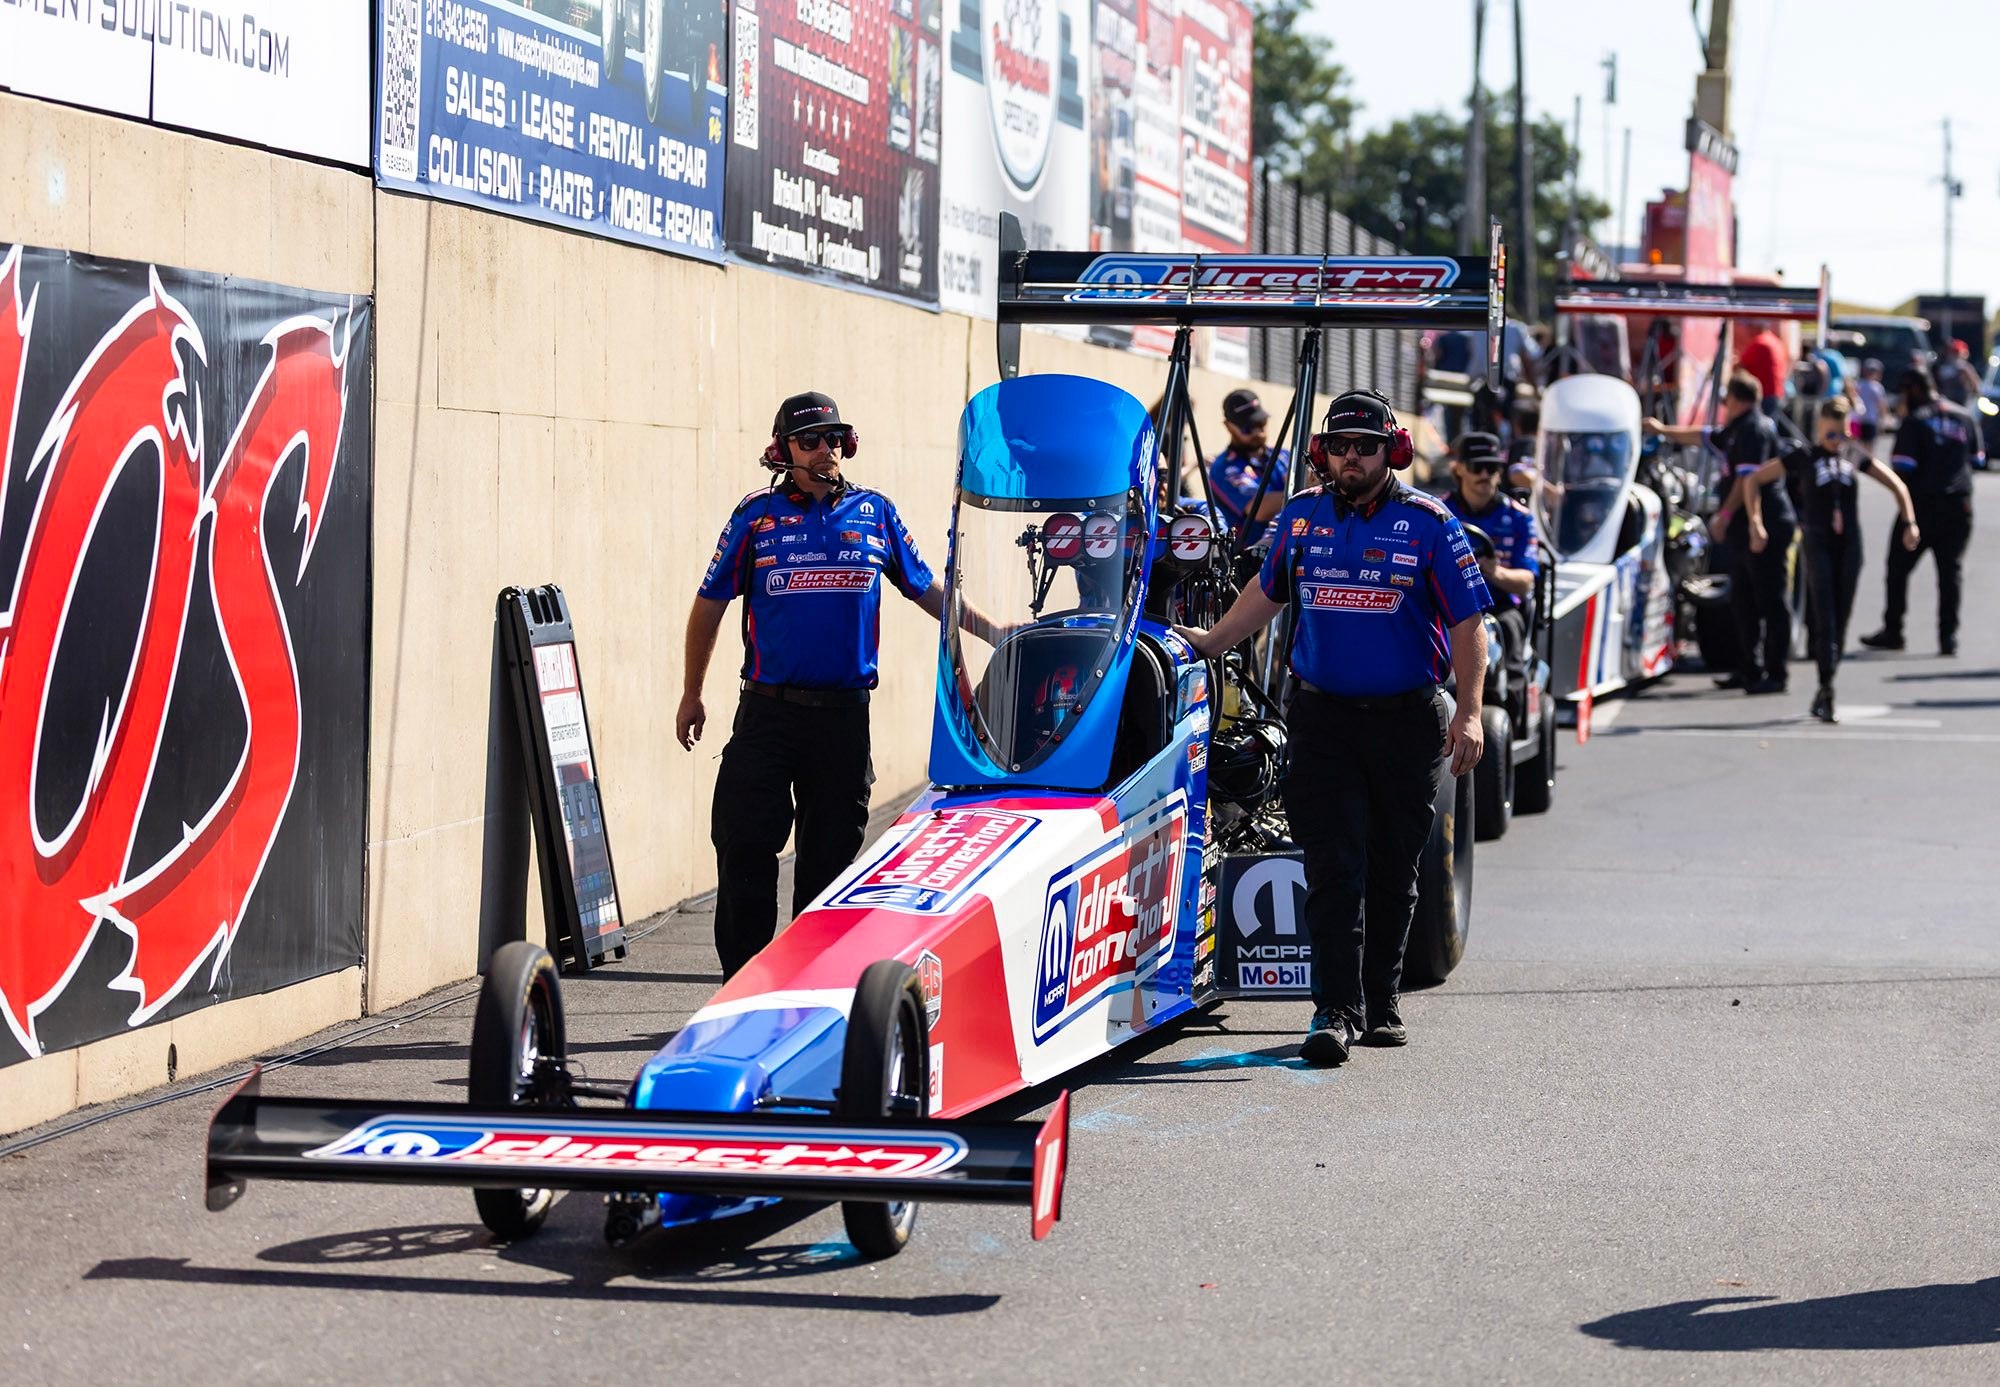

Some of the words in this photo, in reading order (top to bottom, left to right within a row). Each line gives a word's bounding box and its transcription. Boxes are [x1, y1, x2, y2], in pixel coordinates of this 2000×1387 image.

[445, 66, 506, 129] SALES
[521, 90, 575, 150] LEASE
[588, 112, 646, 171] RENTAL
[658, 135, 707, 189] REPAIR
[428, 133, 522, 202] COLLISION
[540, 164, 594, 221] PARTS
[610, 183, 663, 238] MOBILE
[665, 199, 715, 250] REPAIR
[791, 579, 872, 588] connection
[793, 572, 860, 582] direct
[1316, 598, 1395, 608] connection
[1318, 589, 1382, 601] direct
[877, 822, 966, 883] direct
[918, 816, 1017, 887] connection
[1241, 966, 1306, 985] Mobil
[483, 1136, 855, 1166] direct
